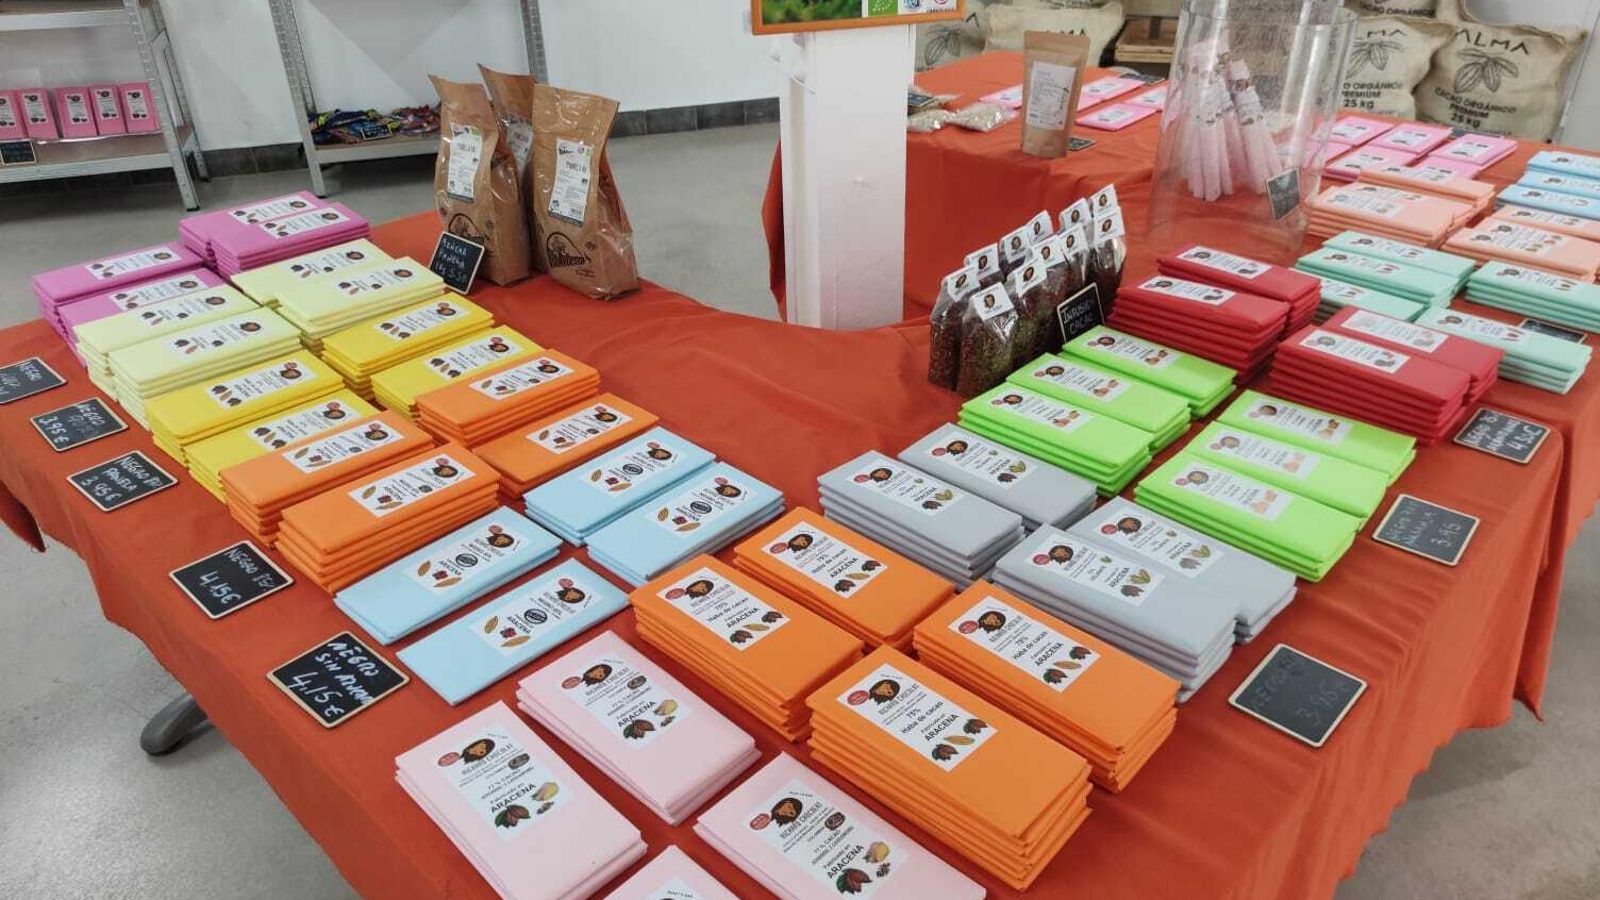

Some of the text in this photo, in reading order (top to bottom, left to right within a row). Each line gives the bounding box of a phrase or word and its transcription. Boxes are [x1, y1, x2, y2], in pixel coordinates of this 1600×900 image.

[1454, 28, 1529, 55] ALMA
[327, 642, 379, 676] NEGRO
[1034, 642, 1062, 665] ARACENA
[618, 700, 654, 727] ARACENA
[901, 720, 918, 734] Haba
[924, 713, 957, 740] ARACENA
[489, 783, 537, 812] ARACENA
[826, 845, 863, 878] ARACENA
